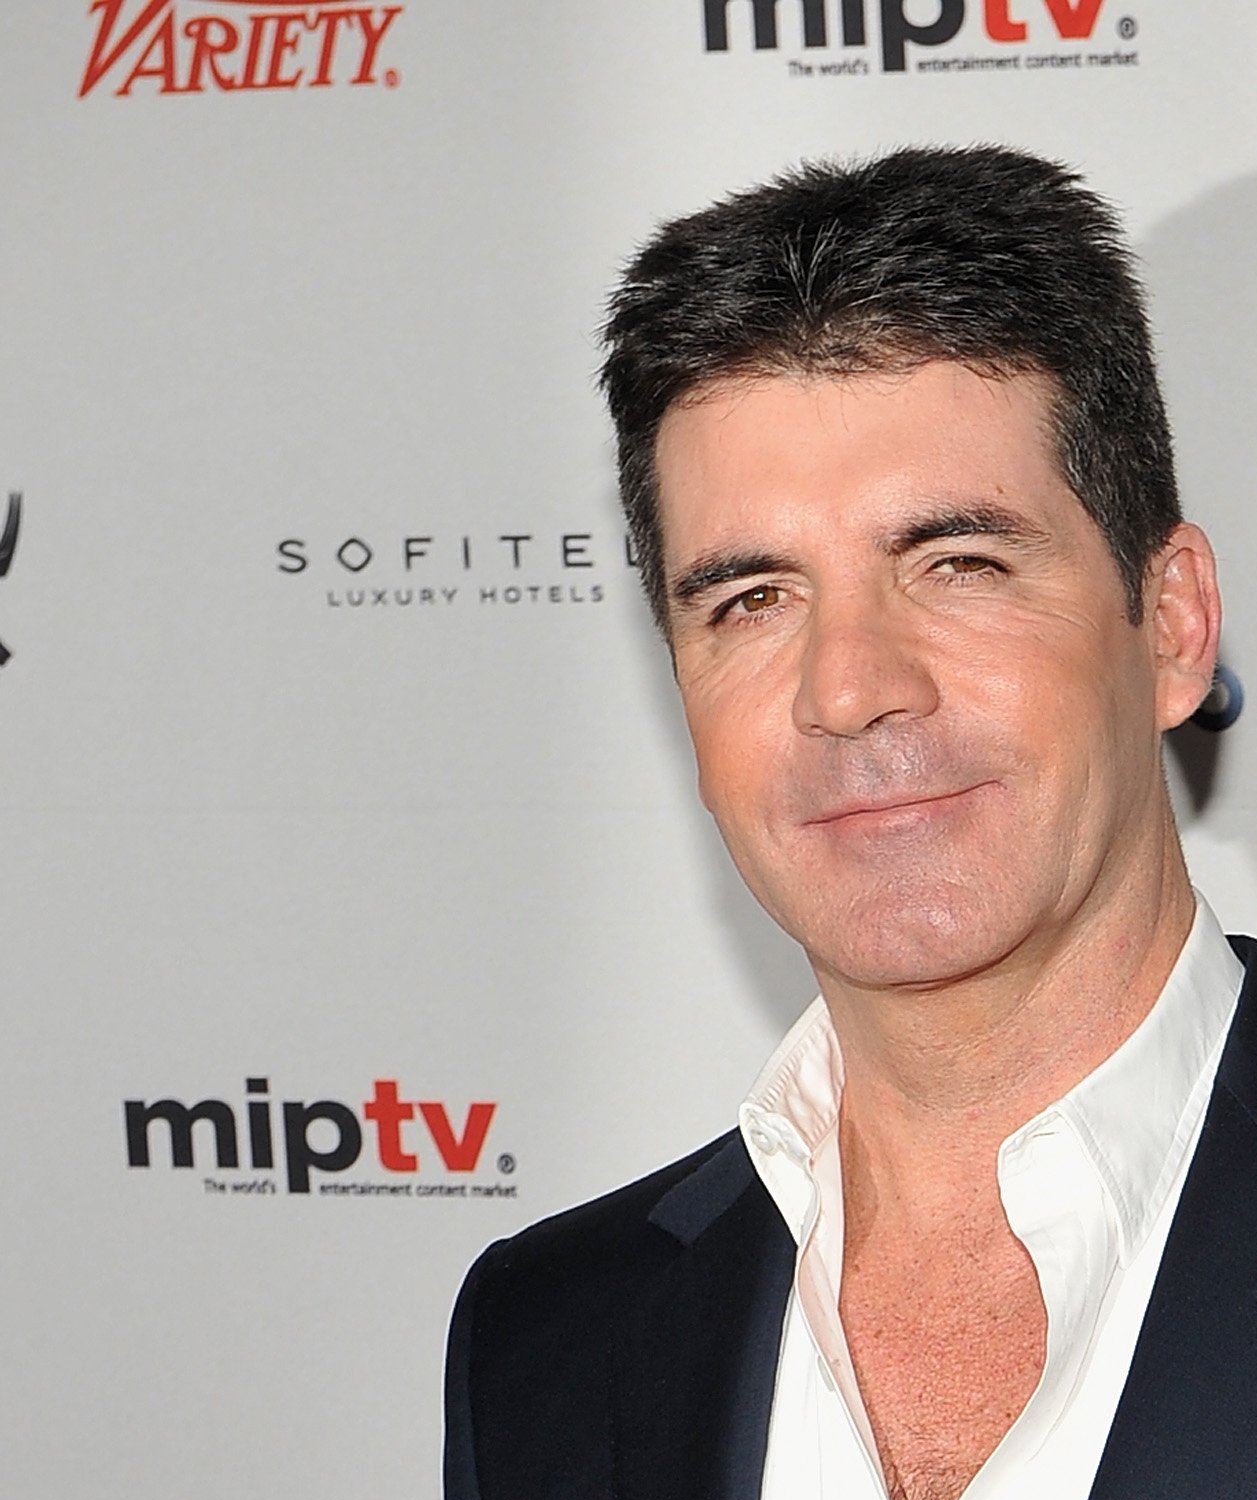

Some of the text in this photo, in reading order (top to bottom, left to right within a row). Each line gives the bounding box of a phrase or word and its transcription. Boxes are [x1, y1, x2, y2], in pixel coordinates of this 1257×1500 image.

[79, 0, 402, 98] VARIETY
[326, 585, 605, 607] LUXURY HOTELS
[124, 1078, 498, 1193] miptv
[319, 1182, 411, 1196] entertainment
[416, 1184, 467, 1198] content
[471, 1184, 517, 1199] market
